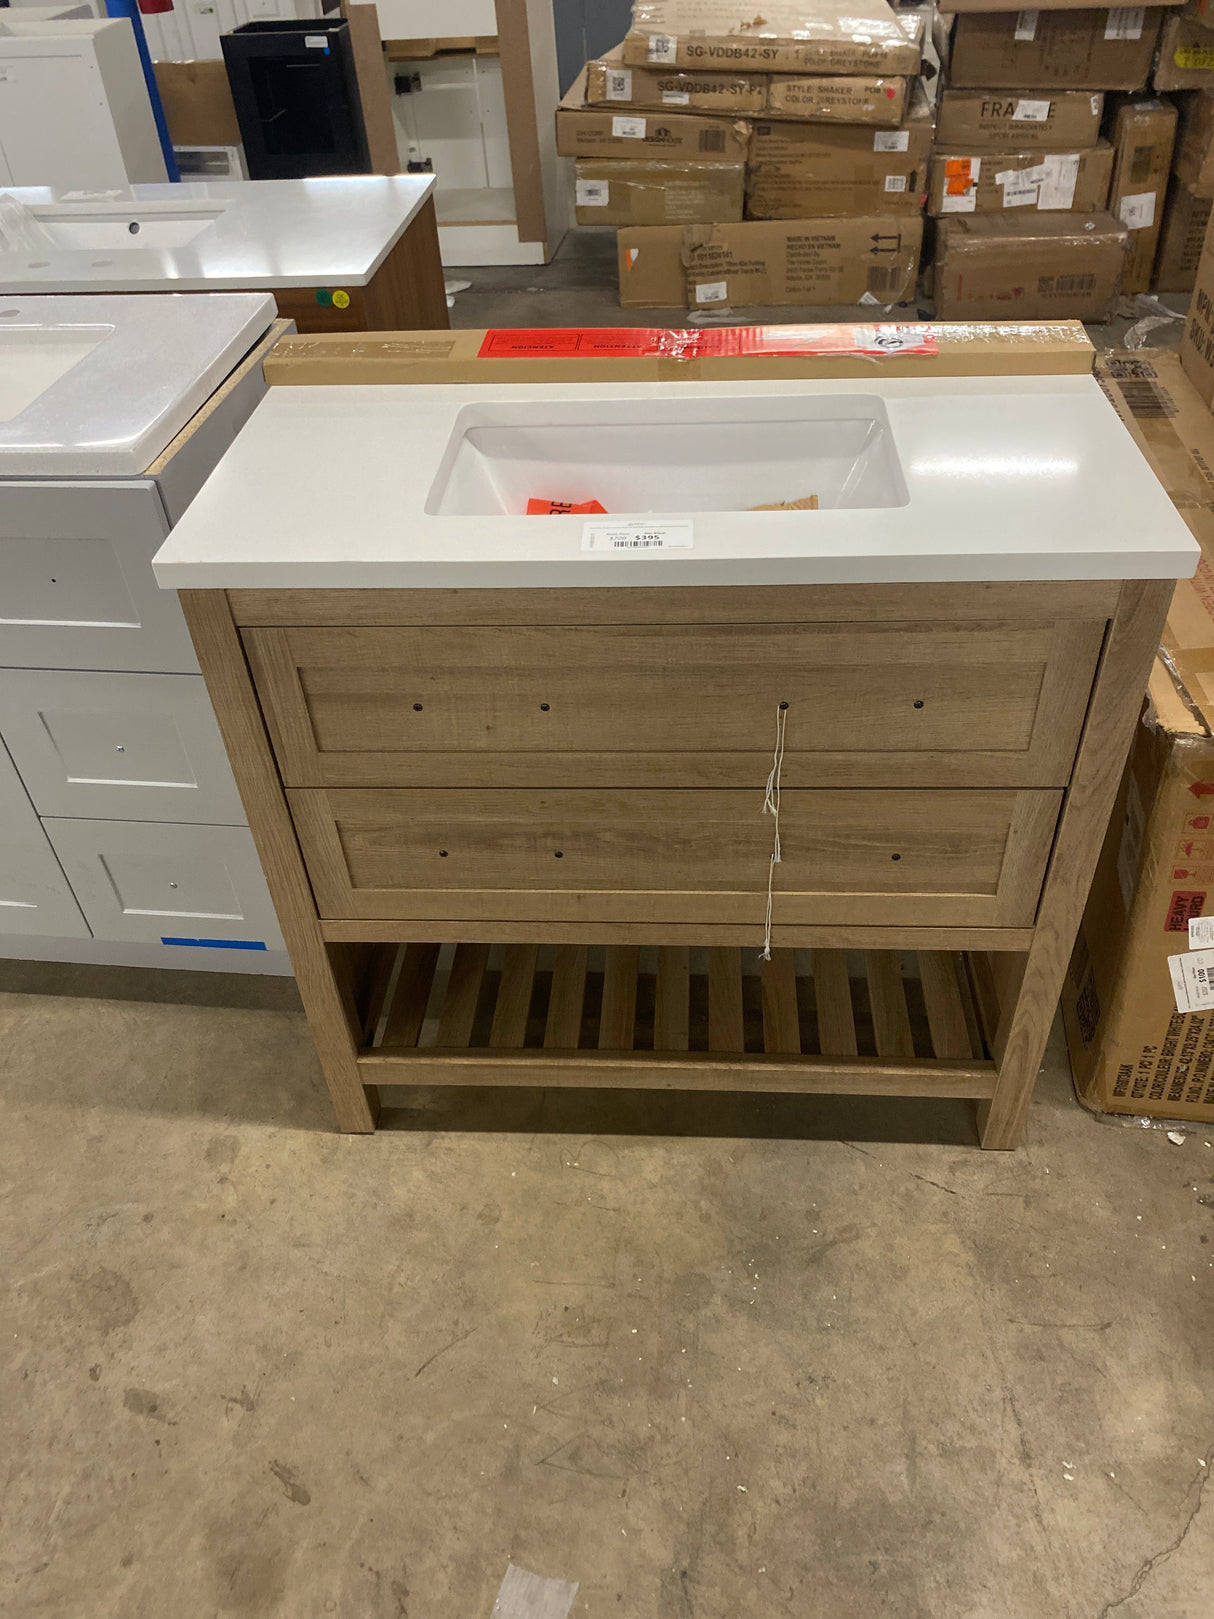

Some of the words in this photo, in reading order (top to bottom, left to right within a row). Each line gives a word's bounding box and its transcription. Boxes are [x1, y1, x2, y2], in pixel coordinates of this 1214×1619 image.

[686, 45, 780, 60] SG-VDDB42-SY
[818, 85, 853, 95] SHAKER
[981, 101, 1056, 118] FRAE
[1169, 895, 1190, 931] HEAVY
[1197, 968, 1208, 983] $100
[1160, 1037, 1179, 1057] BRIGHT
